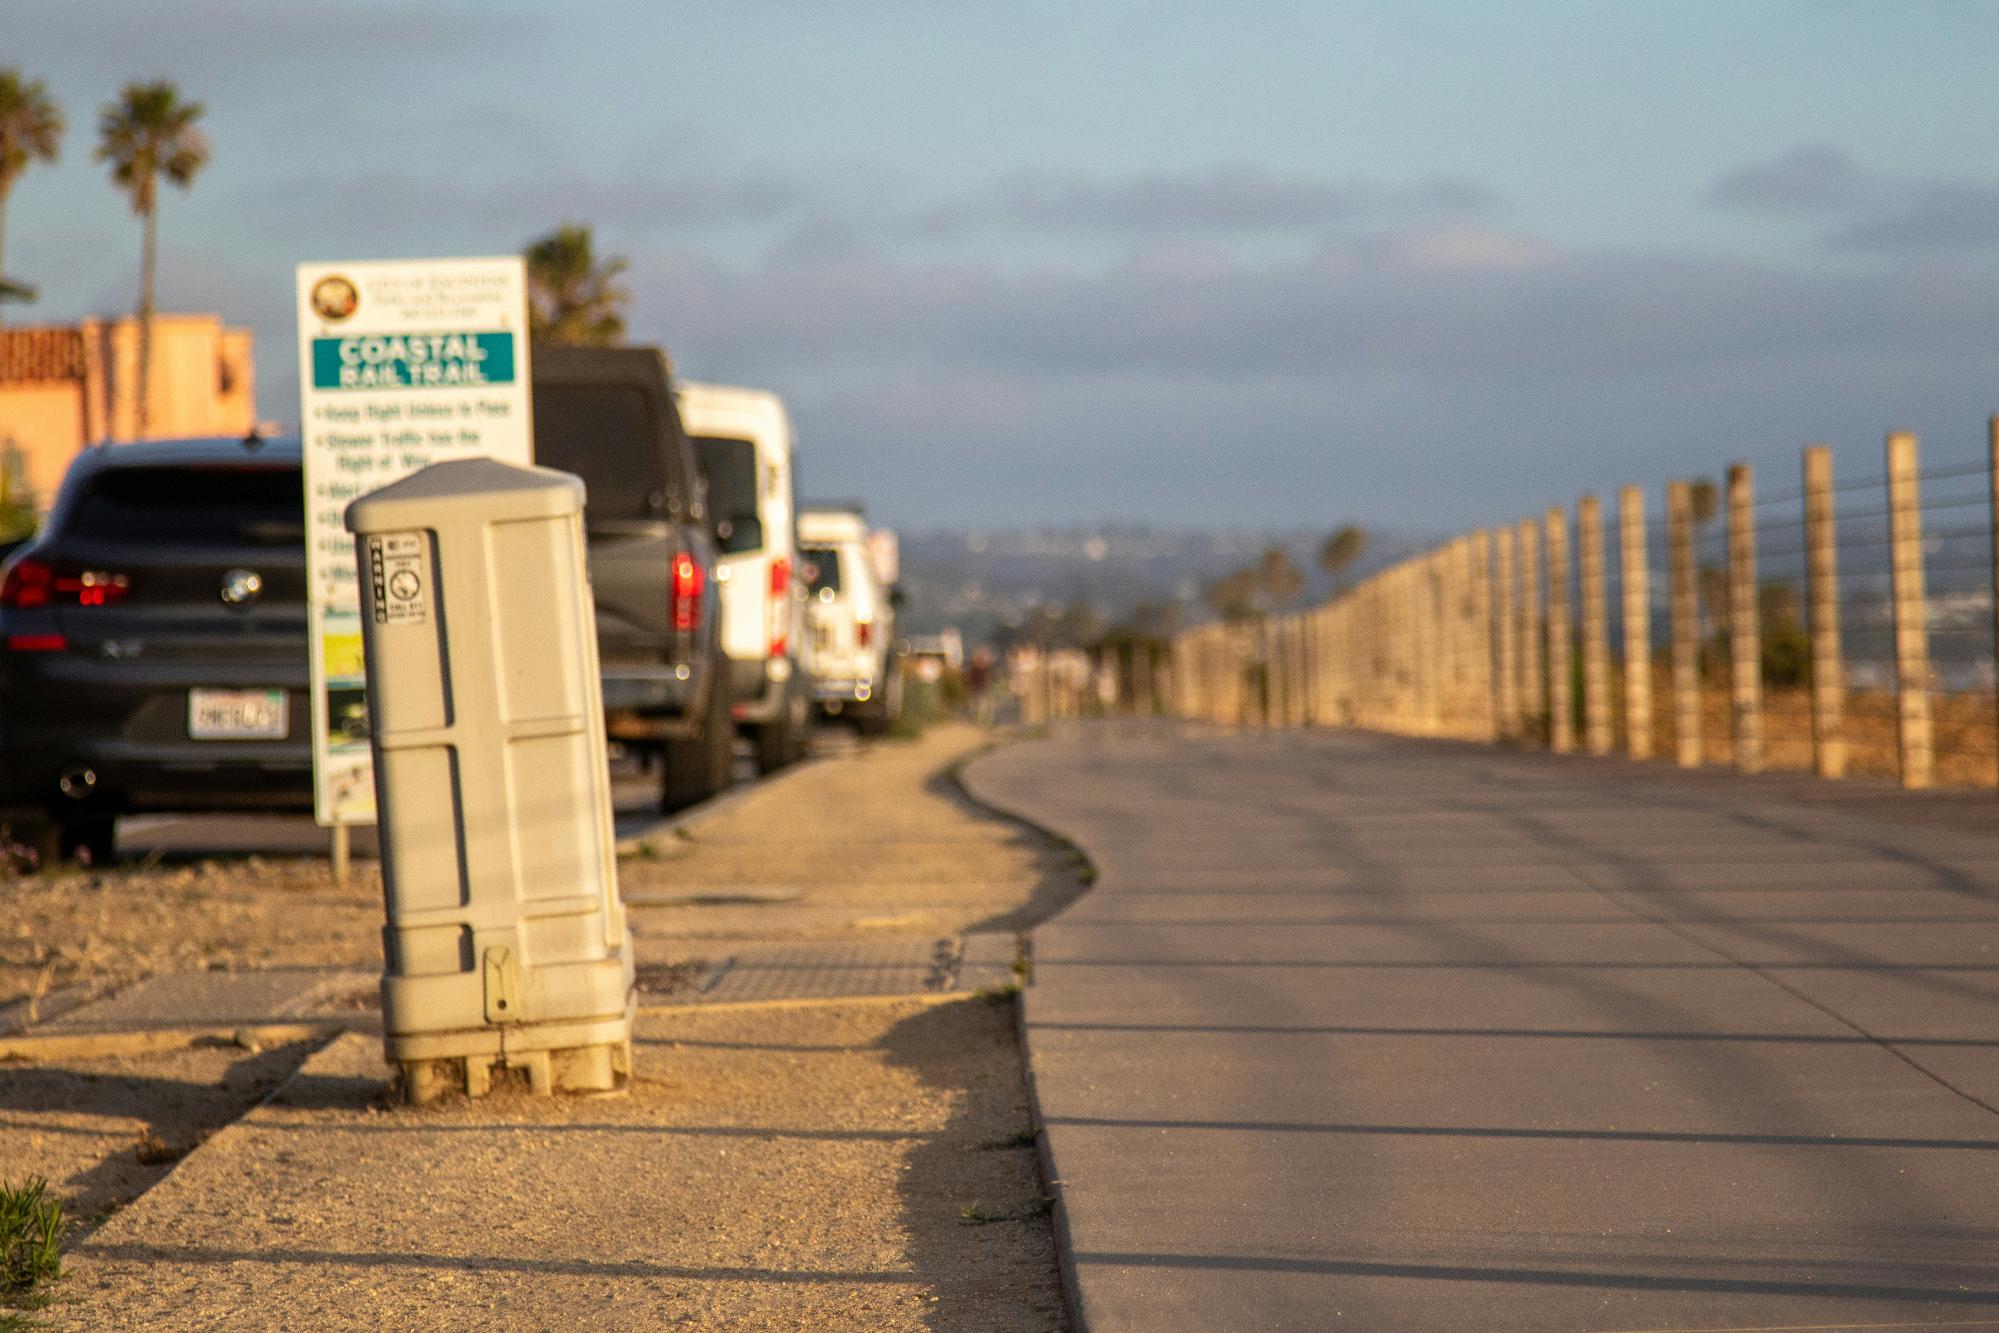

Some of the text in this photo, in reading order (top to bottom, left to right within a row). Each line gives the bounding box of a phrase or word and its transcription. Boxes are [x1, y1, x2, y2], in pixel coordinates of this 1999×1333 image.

[339, 335, 488, 364] COASTAL
[340, 360, 489, 388] RAIL TRAIL
[370, 538, 387, 622] WARNING
